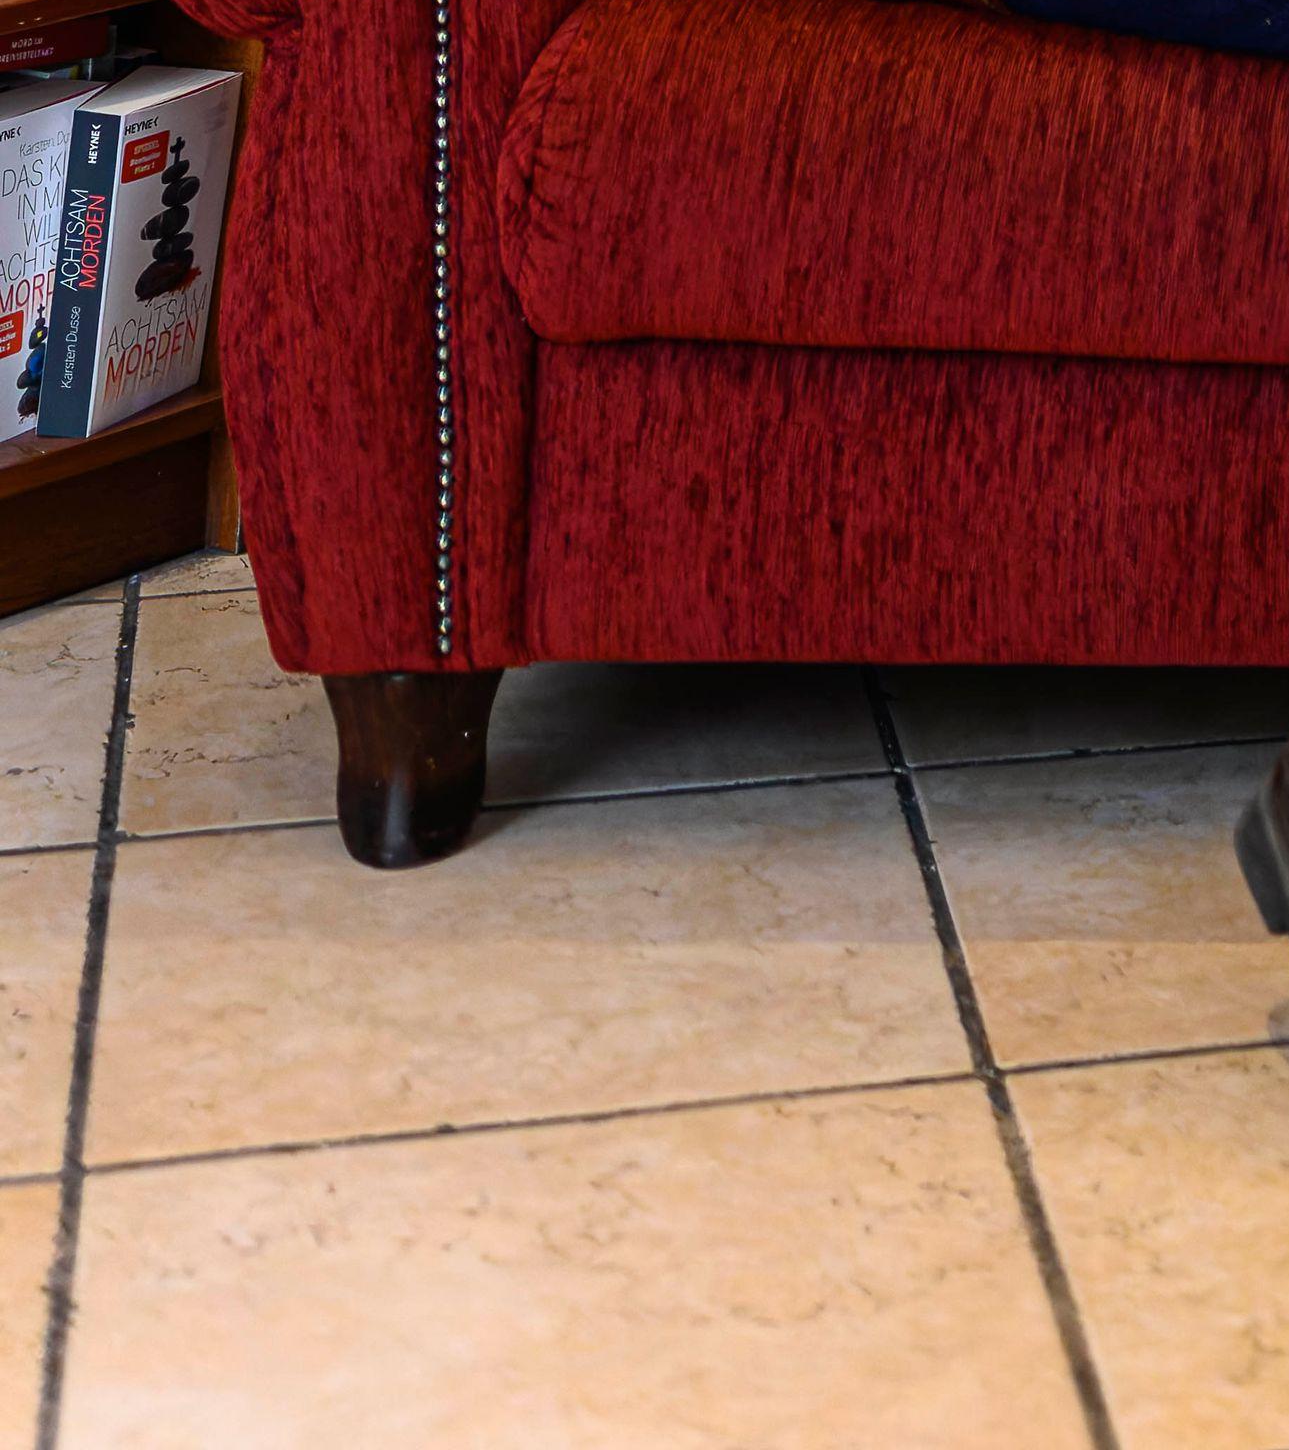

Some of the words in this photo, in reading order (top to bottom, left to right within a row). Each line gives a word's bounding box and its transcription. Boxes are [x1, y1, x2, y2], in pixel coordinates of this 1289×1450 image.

[124, 119, 154, 136] HEYNE
[59, 188, 89, 292] ACHTSAM
[79, 194, 105, 289] MORDEN
[66, 306, 81, 342] Dusse
[61, 343, 76, 391] Karsten
